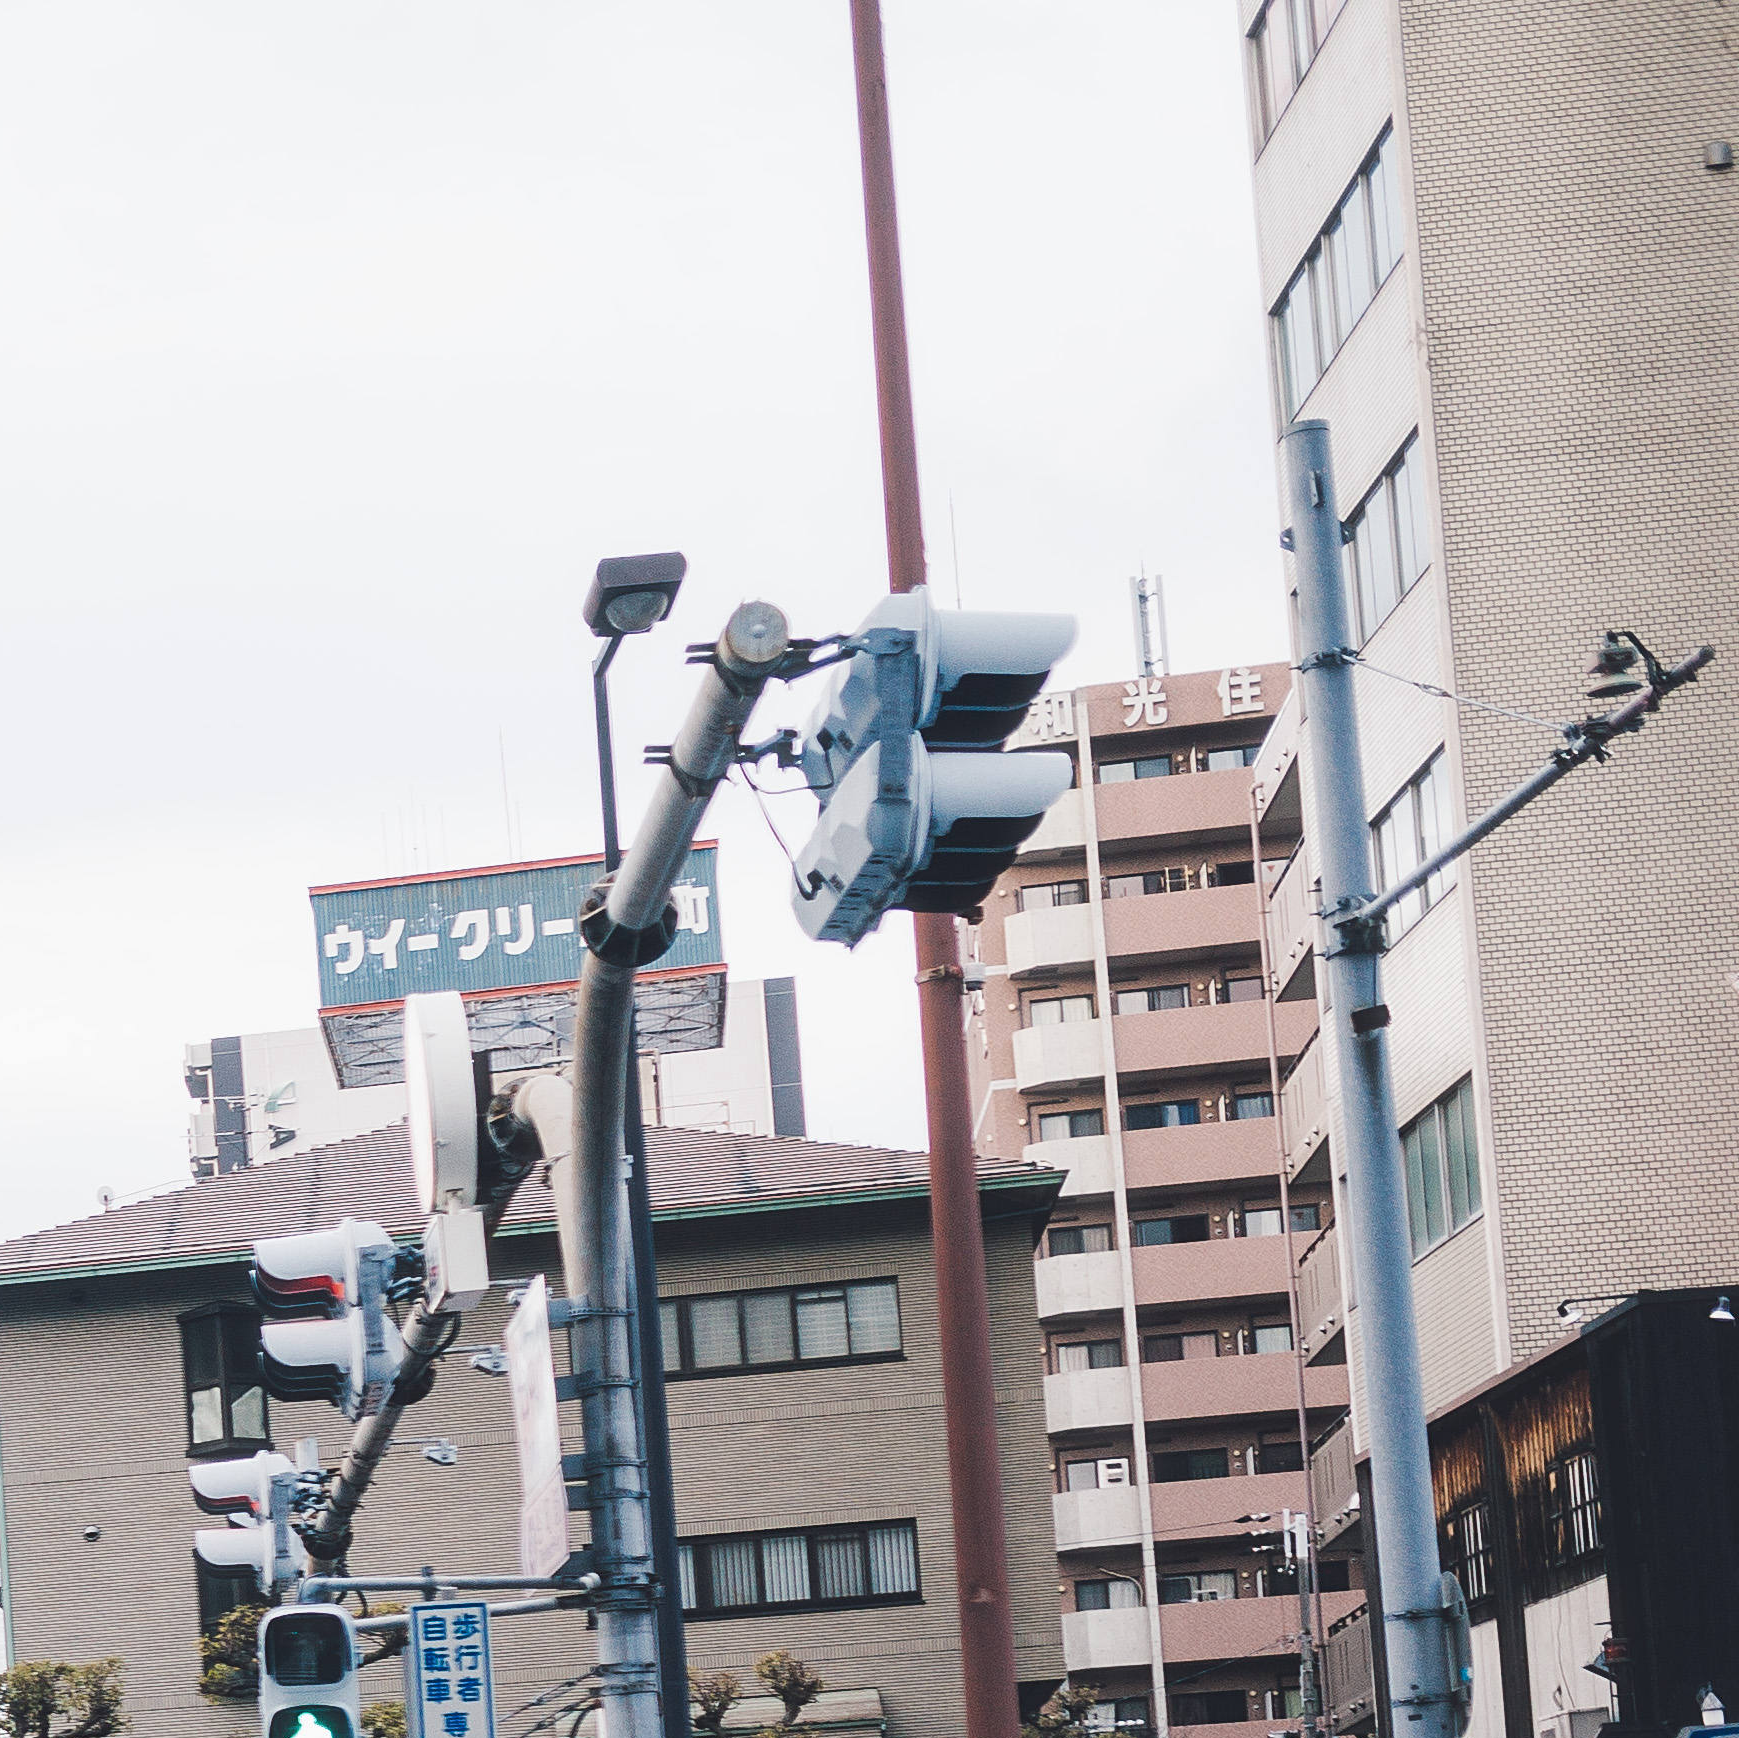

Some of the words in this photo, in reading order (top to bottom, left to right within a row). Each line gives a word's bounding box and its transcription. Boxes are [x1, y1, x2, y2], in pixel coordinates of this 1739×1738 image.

[423, 1616, 451, 1704] 自転車
[453, 1614, 484, 1703] 歩行者
